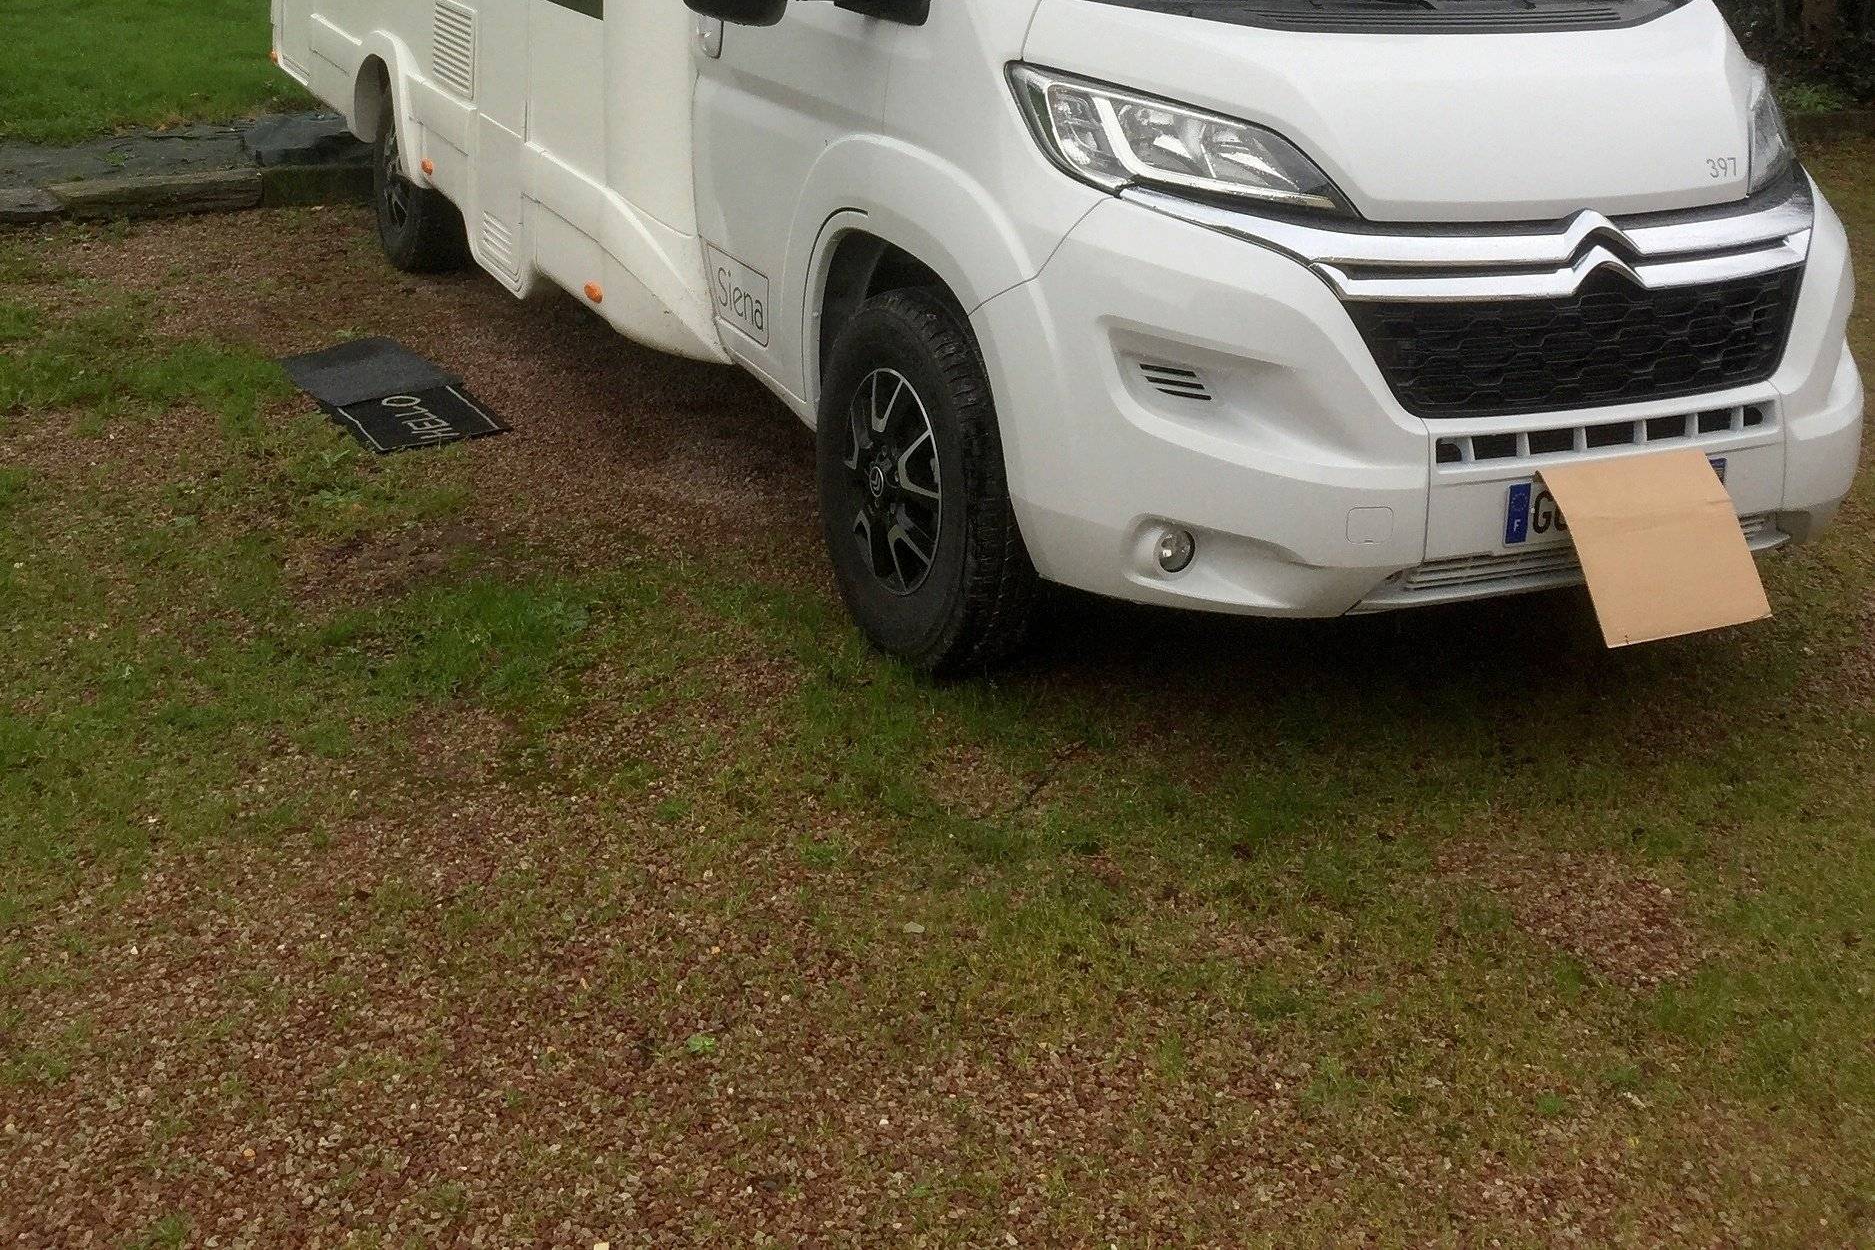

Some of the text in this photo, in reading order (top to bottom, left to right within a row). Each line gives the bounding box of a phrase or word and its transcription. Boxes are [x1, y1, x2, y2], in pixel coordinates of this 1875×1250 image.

[1706, 157, 1736, 178] 397
[718, 267, 763, 331] Siena
[382, 395, 460, 440] HELLO
[1513, 518, 1521, 532] F
